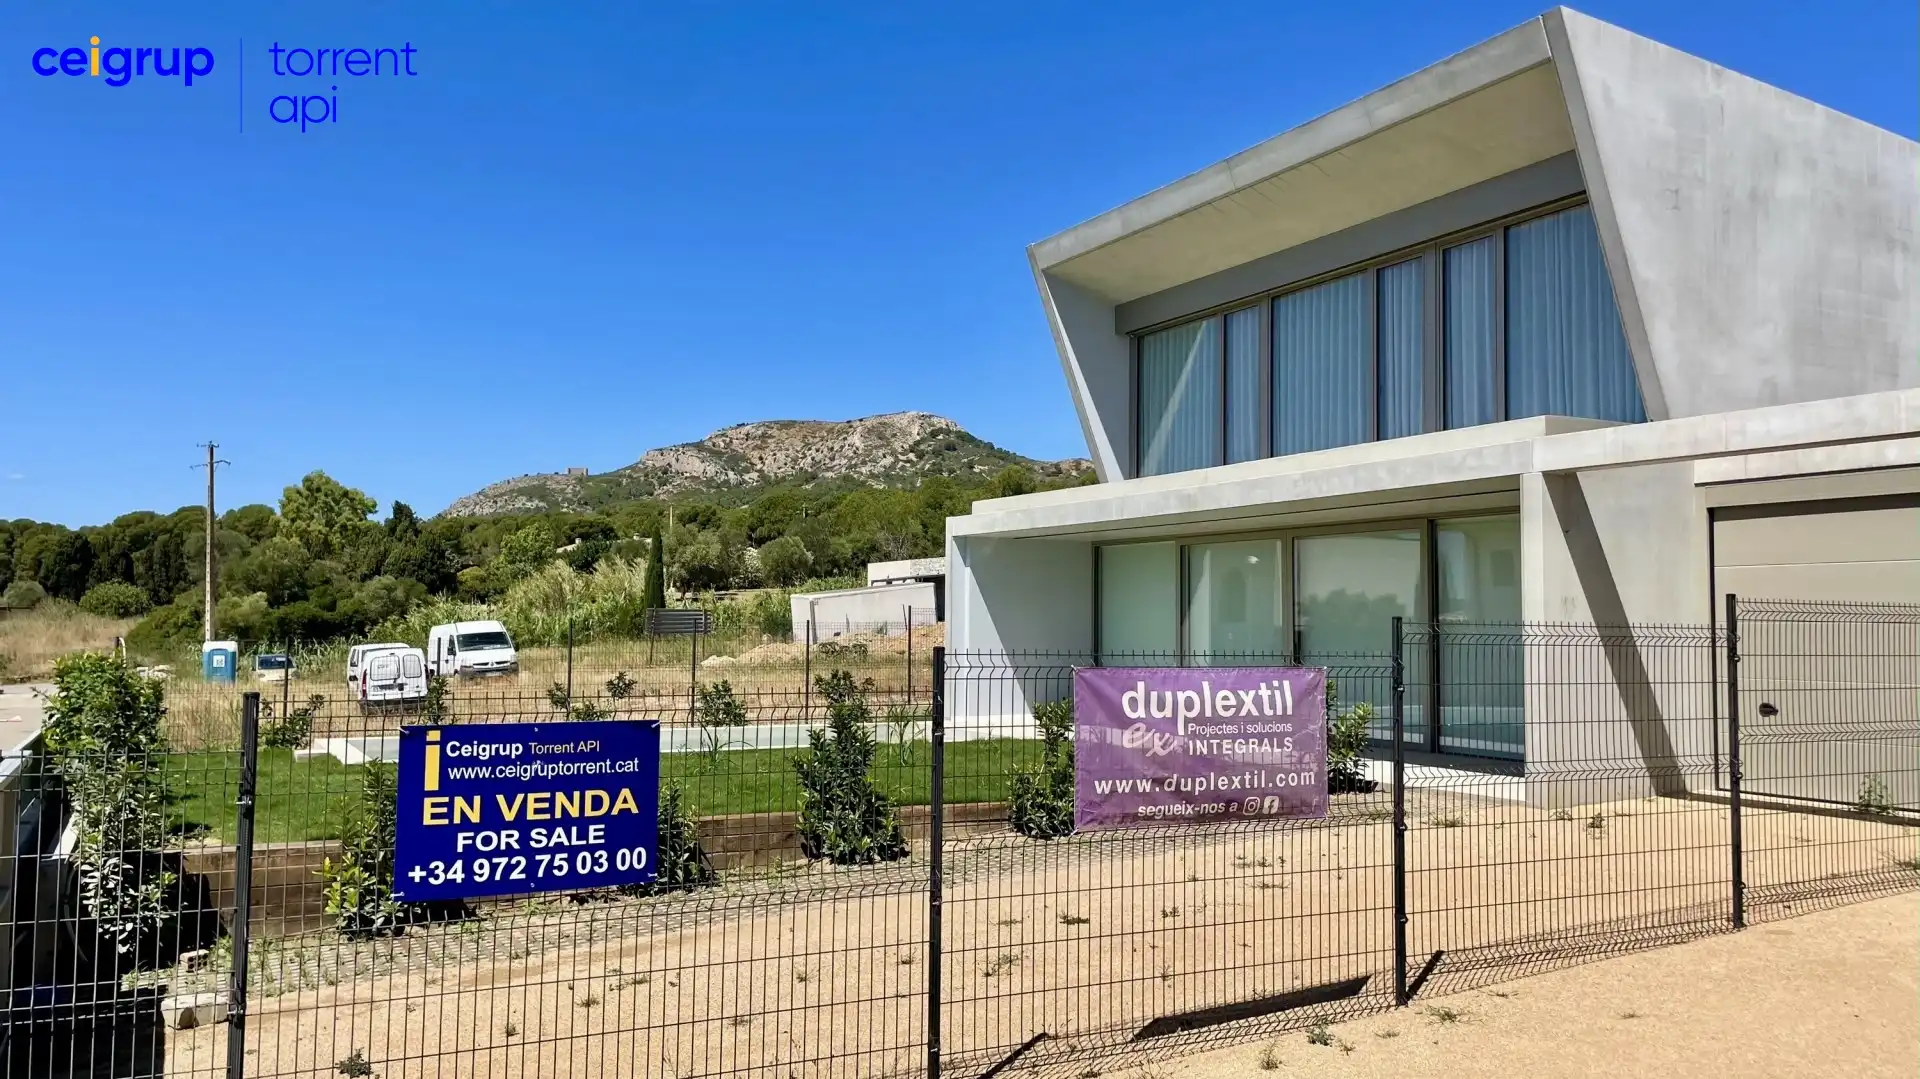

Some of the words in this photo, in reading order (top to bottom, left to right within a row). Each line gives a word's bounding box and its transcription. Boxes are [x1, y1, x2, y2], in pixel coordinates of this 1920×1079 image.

[1121, 680, 1293, 735] duplextil
[1188, 723, 1239, 738] Projectes
[1246, 721, 1293, 734] solucions
[446, 741, 523, 760] Ceigrup
[529, 742, 575, 755] Torrent
[577, 740, 600, 753] API
[1188, 736, 1293, 756] INTEGRALS
[448, 757, 639, 781] www.ceigruptorrent.cat
[1094, 770, 1316, 796] www.duplextil.com
[423, 795, 481, 825] EN
[496, 788, 639, 822] VENDA
[1137, 800, 1226, 819] segueix-nos
[1229, 803, 1238, 813] a
[457, 829, 520, 853] FOR
[529, 824, 606, 848] SALE
[408, 859, 465, 885] +34
[473, 855, 526, 882] 972
[535, 853, 569, 877] 75
[576, 849, 609, 874] 03
[616, 846, 647, 870] 00
